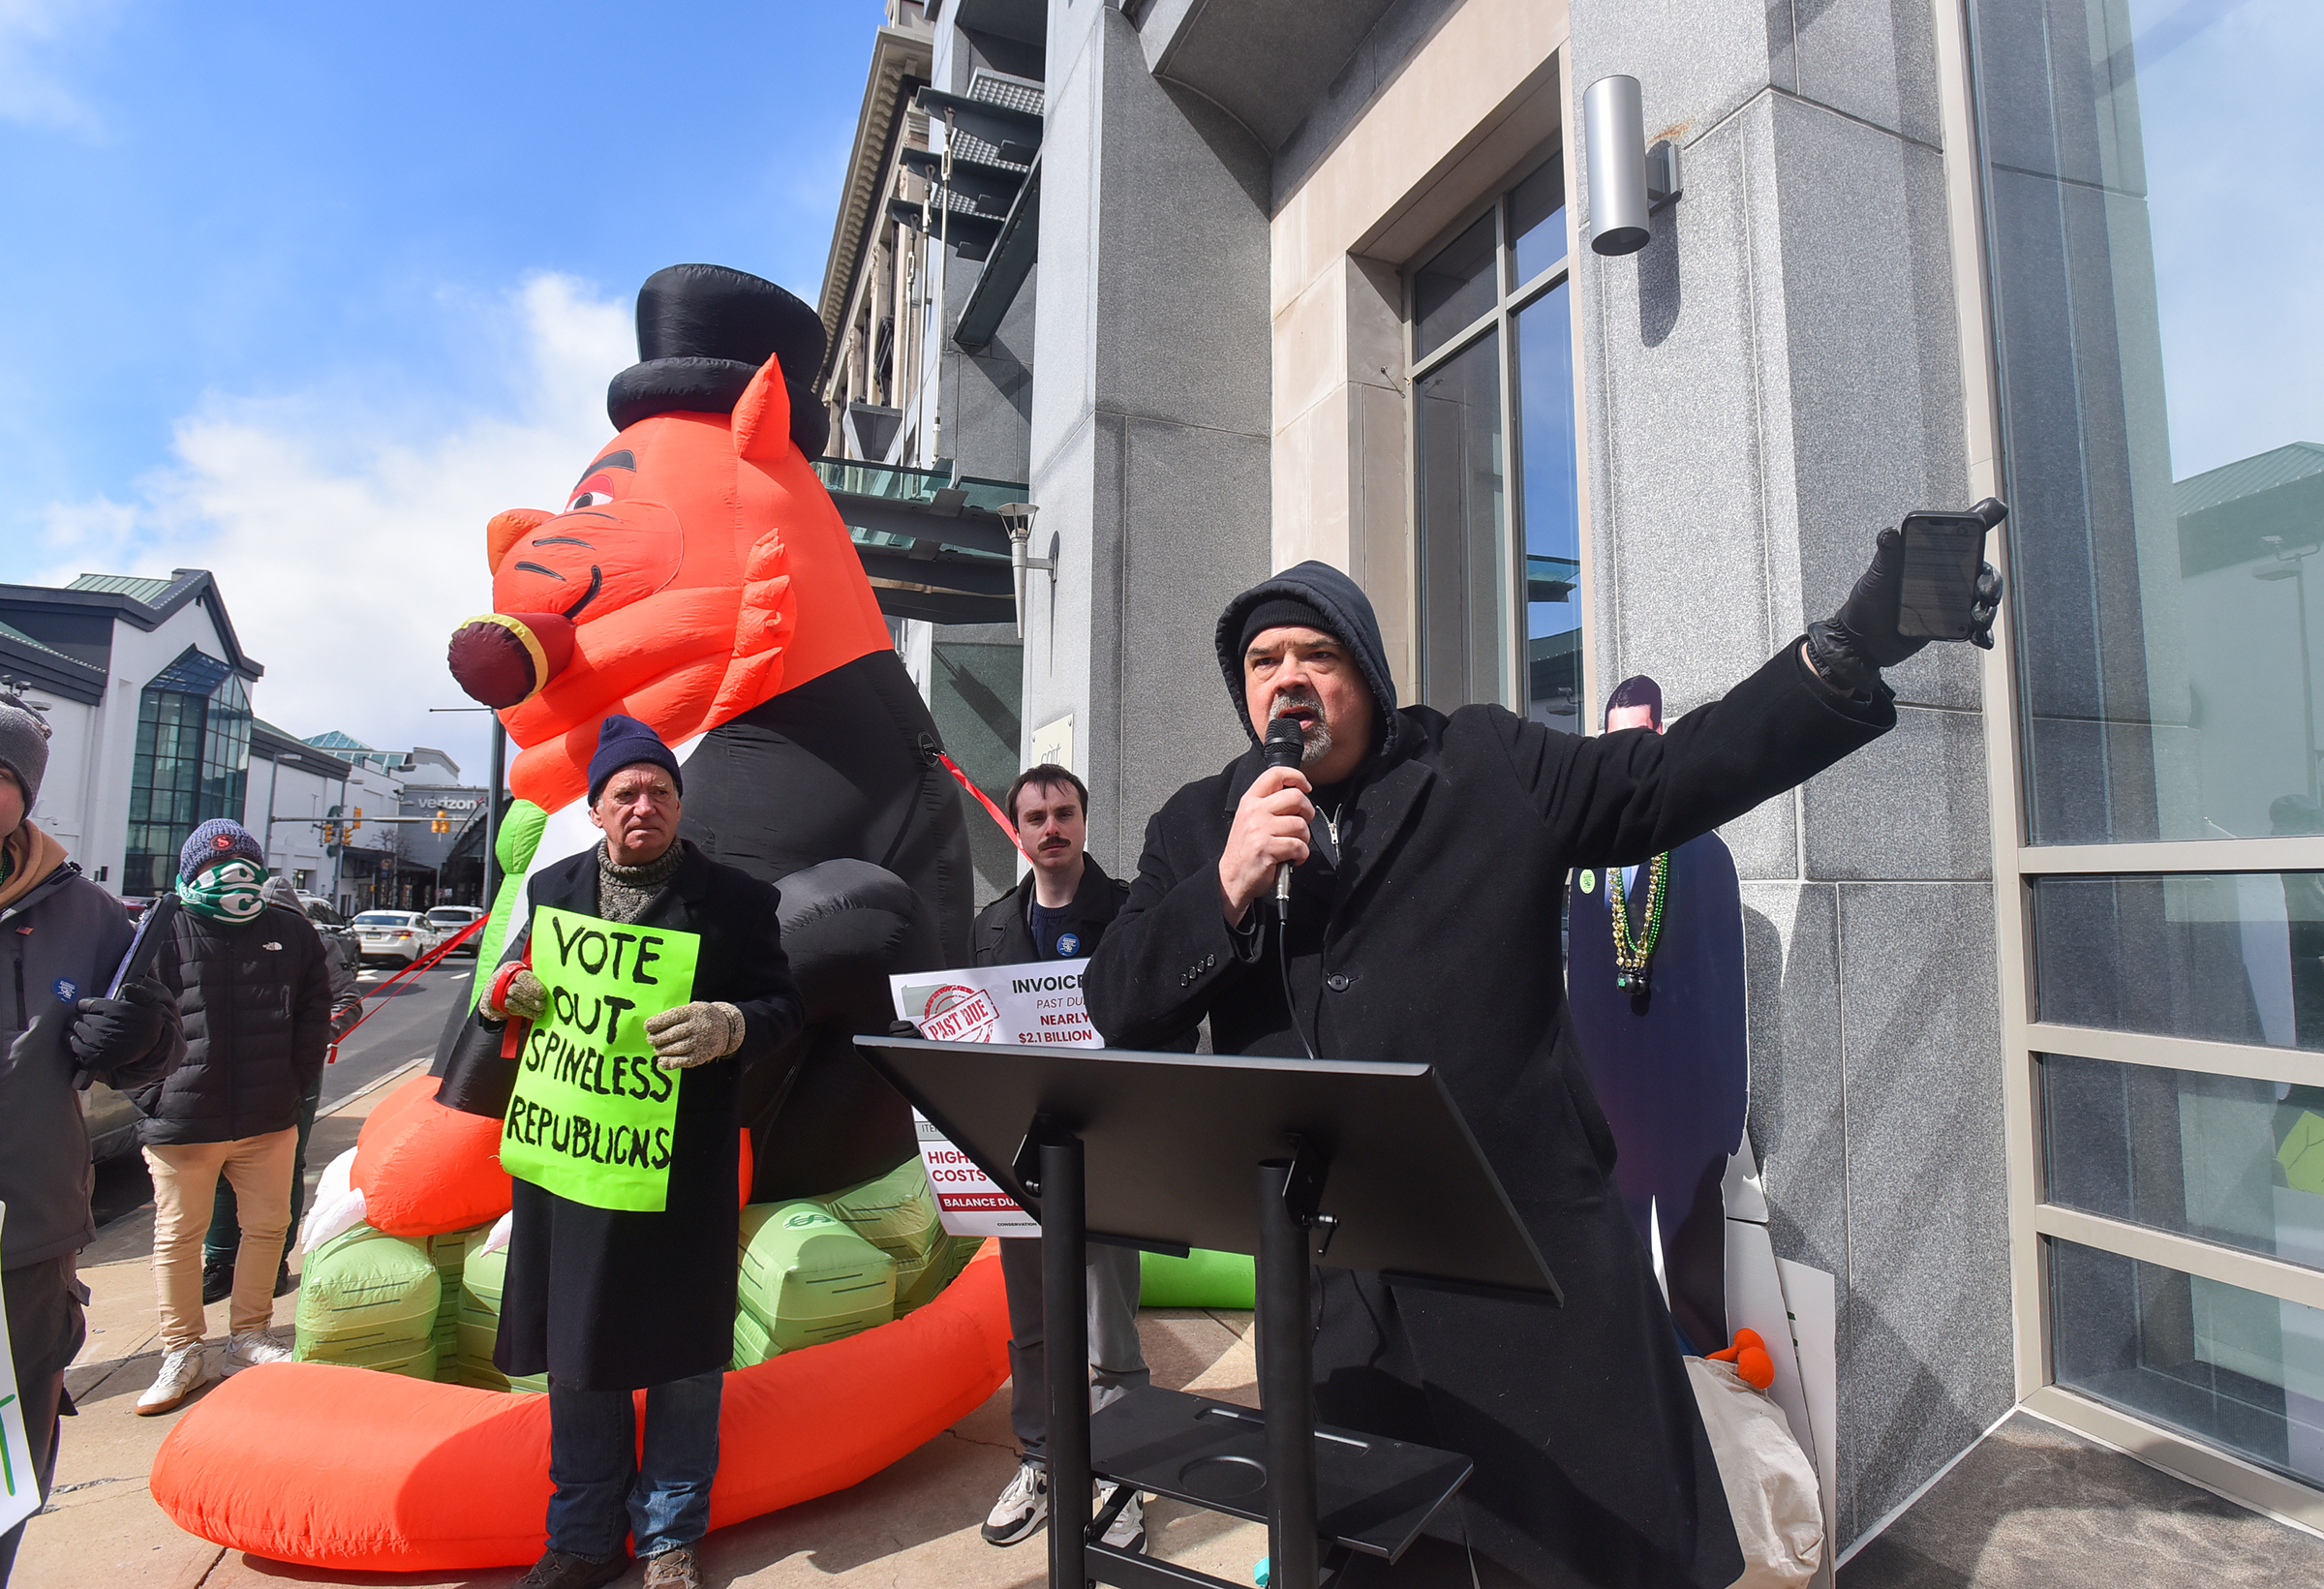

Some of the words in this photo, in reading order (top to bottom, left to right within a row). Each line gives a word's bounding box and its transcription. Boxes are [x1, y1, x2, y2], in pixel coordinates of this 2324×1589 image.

[417, 796, 476, 810] verizon
[552, 916, 664, 985] VOTE
[1036, 997, 1063, 1009] PAST
[1066, 996, 1085, 1007] DU
[553, 986, 637, 1044] OUT
[929, 1012, 963, 1041] PAST
[960, 998, 989, 1026] DUE
[1040, 1012, 1088, 1025] NEARLY
[1018, 1032, 1042, 1044] $2.1
[1044, 1029, 1092, 1043] BILLION
[526, 1028, 673, 1103] SPINELESS
[928, 1151, 973, 1164] HIGH
[932, 1170, 988, 1182] COSTS
[943, 1198, 996, 1207] BALANCE
